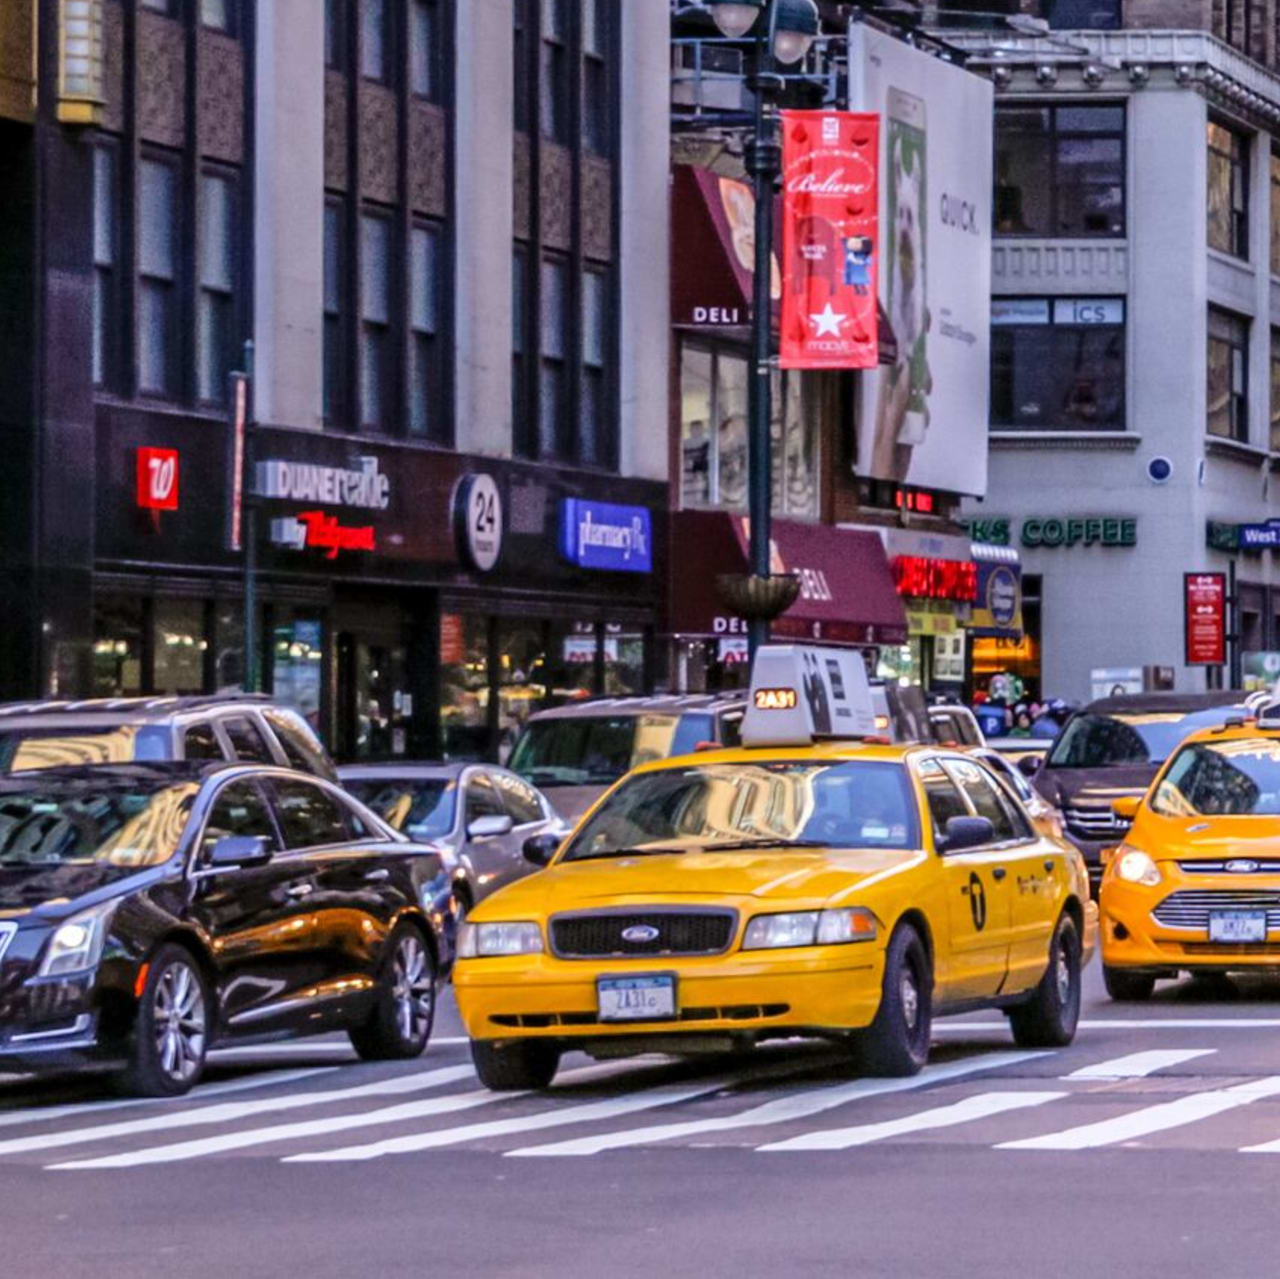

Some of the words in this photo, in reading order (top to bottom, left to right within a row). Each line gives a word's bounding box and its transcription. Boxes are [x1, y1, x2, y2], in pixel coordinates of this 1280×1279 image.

[787, 169, 871, 194] Believe
[693, 306, 739, 324] DELI
[475, 491, 495, 533] 24
[1021, 517, 1137, 548] COFFEE
[1245, 530, 1276, 543] West
[755, 691, 796, 709] 2A31
